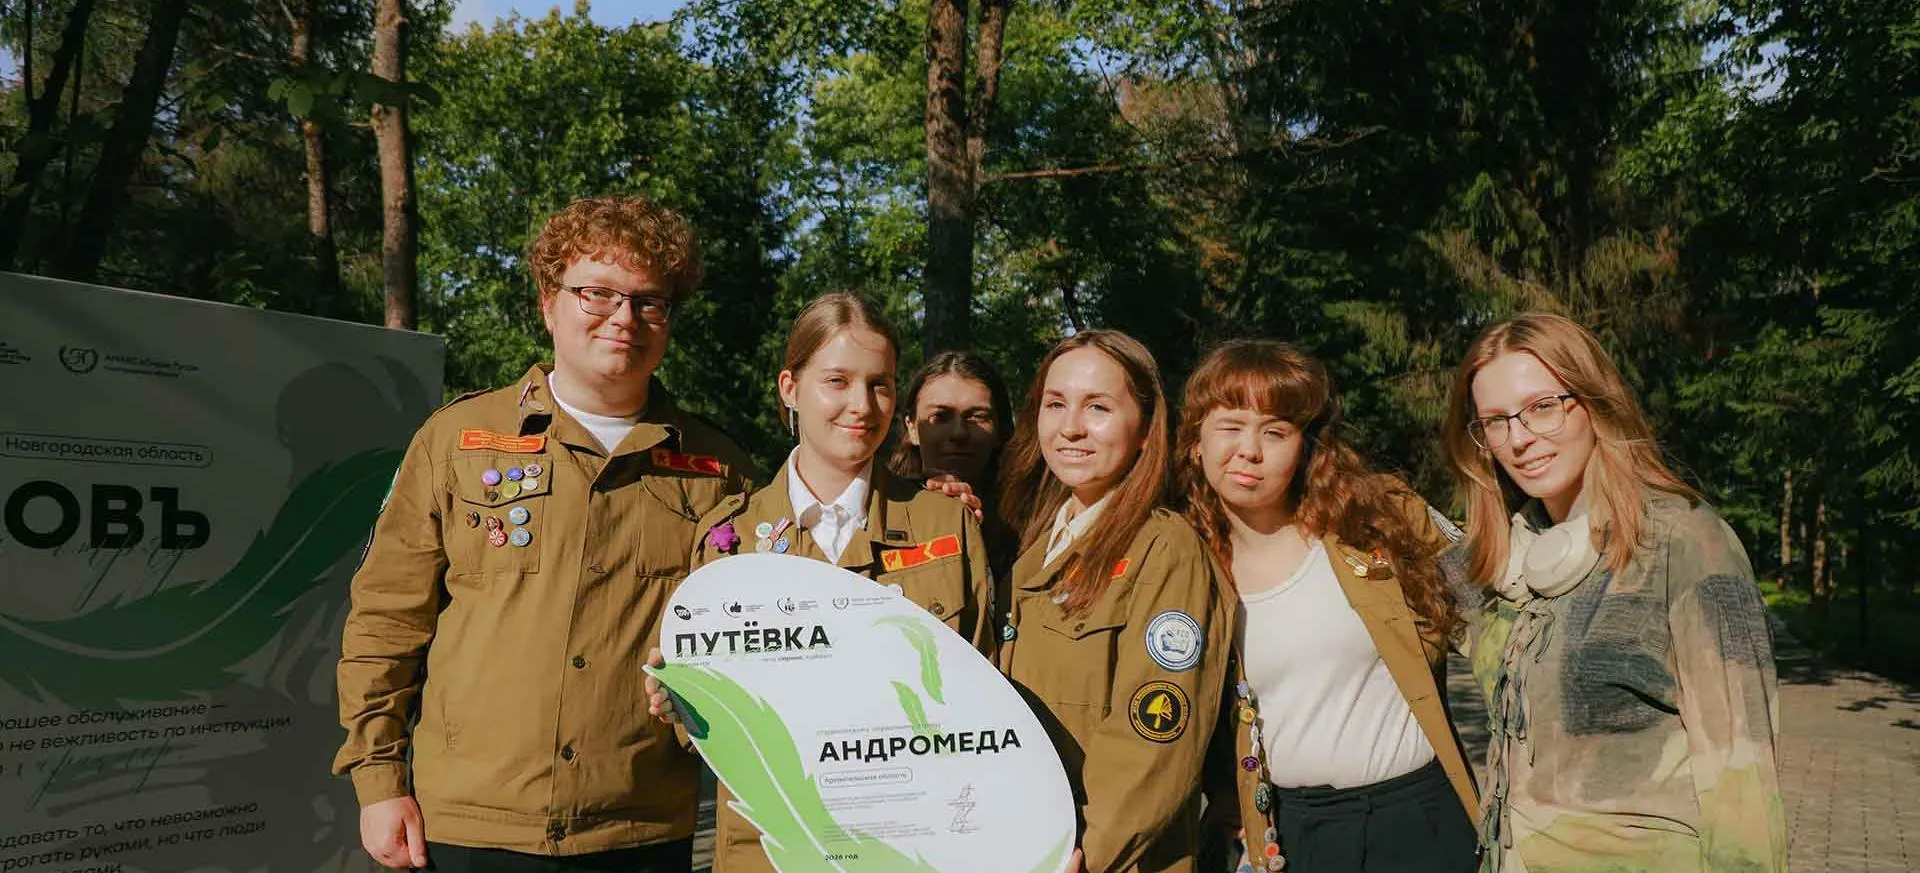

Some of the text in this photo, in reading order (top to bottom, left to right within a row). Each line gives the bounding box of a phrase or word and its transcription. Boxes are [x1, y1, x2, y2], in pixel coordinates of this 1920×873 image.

[6, 436, 203, 462] Новгородская область
[675, 620, 832, 658] ПУТЁВКА
[66, 704, 207, 725] обслуживание
[9, 739, 37, 754] не
[40, 728, 159, 750] вежливость
[164, 724, 186, 740] по
[189, 714, 292, 736] инструкции
[818, 728, 1022, 763] АНДРОМЕДА
[85, 822, 107, 838] то,
[114, 817, 146, 832] что
[150, 801, 259, 827] невозможно
[157, 832, 181, 848] но
[184, 827, 215, 843] что
[219, 819, 267, 838] люди
